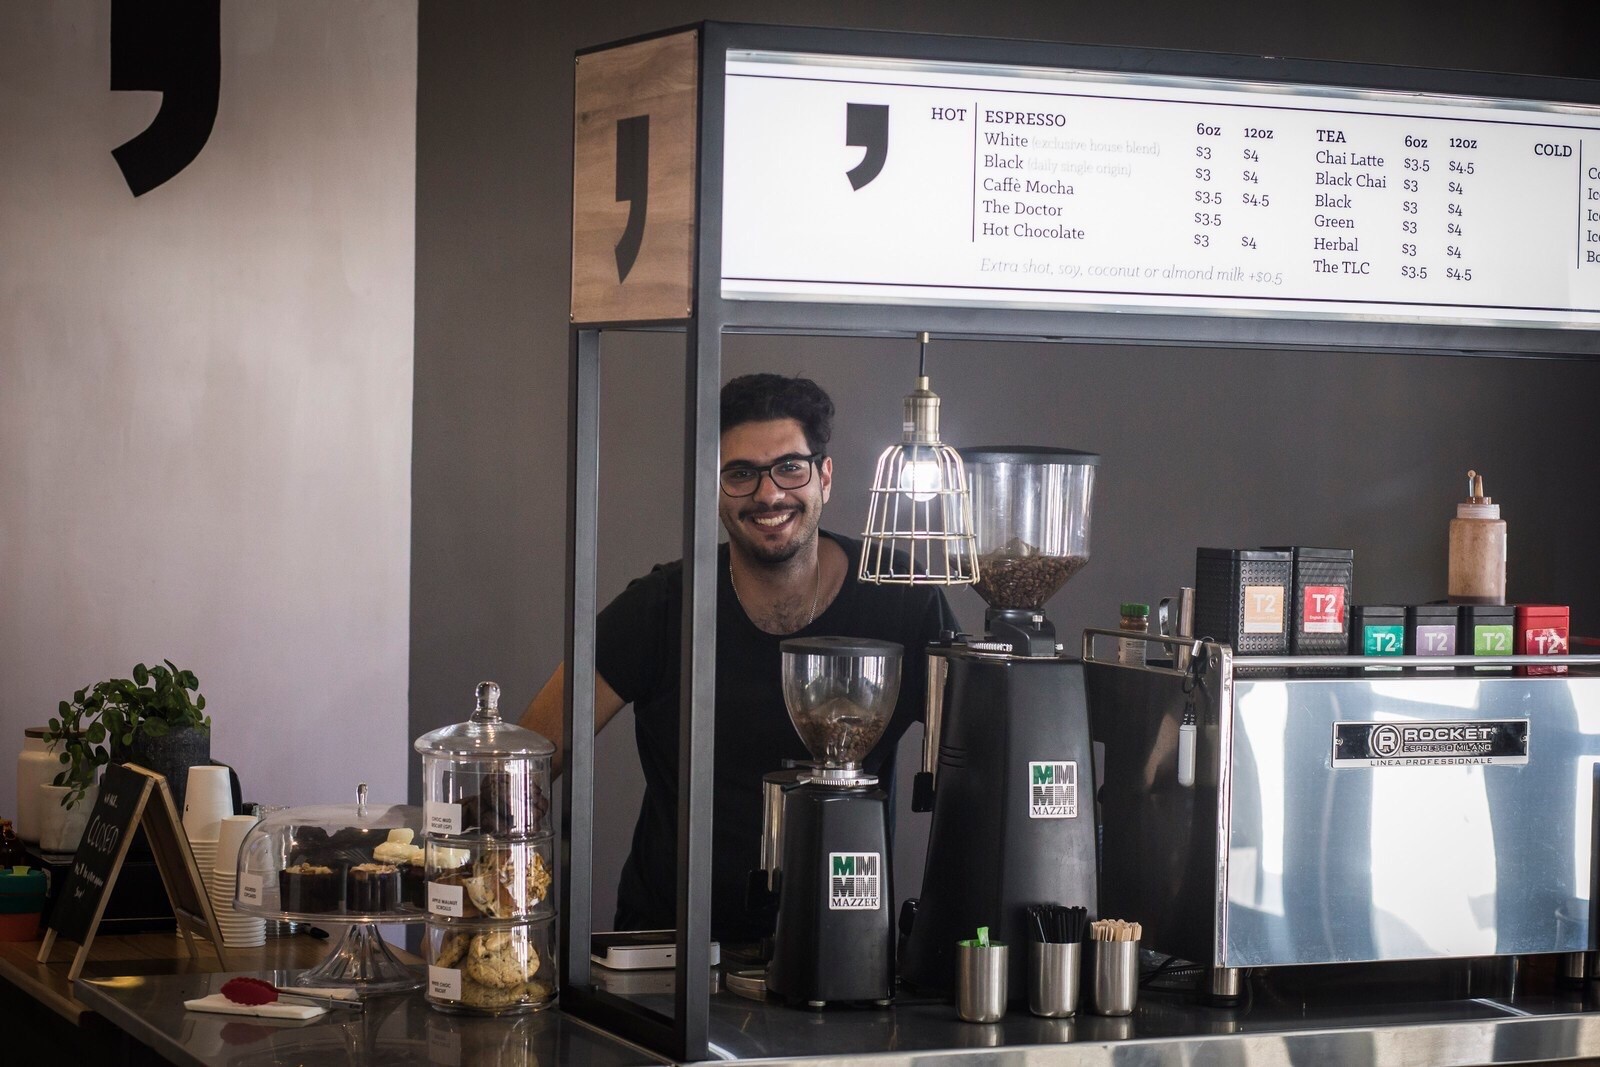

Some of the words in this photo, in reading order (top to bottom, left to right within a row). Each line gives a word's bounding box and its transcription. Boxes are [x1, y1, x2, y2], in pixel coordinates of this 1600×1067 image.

[931, 107, 967, 122] HOT
[985, 111, 1066, 127] ESPRESSO
[1196, 123, 1221, 136] 6oz
[1244, 128, 1274, 140] 12oz
[1316, 130, 1346, 143] TEA
[984, 132, 1028, 147] White
[1032, 136, 1087, 150] (exclusive
[1090, 139, 1124, 153] house
[1126, 141, 1160, 156] blend)
[1404, 136, 1428, 148] 6oz
[1450, 138, 1477, 149] 12oz
[1534, 143, 1572, 157] COLD
[1196, 146, 1211, 160] $3
[1243, 148, 1259, 162] $4
[1316, 151, 1346, 165] Chai
[1350, 153, 1384, 167] Latte
[984, 155, 1024, 170] Black
[1028, 158, 1058, 173] (daily
[1061, 160, 1093, 175] single
[1096, 164, 1131, 177] origin)
[1404, 158, 1430, 172] $3.5
[1449, 161, 1474, 174] $4.5
[1196, 168, 1211, 181] $3
[1243, 170, 1258, 184] $4
[1316, 172, 1352, 186] Black
[1356, 175, 1386, 188] Chai
[983, 178, 1021, 192] Caffè
[1026, 180, 1074, 195] Mocha
[1404, 180, 1418, 192] $3
[1448, 182, 1463, 194] $4
[1588, 188, 1600, 200] Ic
[1195, 191, 1222, 204] $3.5
[1242, 193, 1269, 207] $4.5
[1315, 194, 1352, 208] Black
[983, 201, 1010, 214] The
[1014, 202, 1063, 216] Doctor
[1403, 201, 1418, 214] $3
[1448, 203, 1462, 216] $4
[1588, 209, 1600, 222] Ic
[1194, 212, 1222, 226] $3.5
[1314, 215, 1354, 228] Green
[983, 223, 1010, 237] Hot
[1014, 225, 1085, 240] Chocolate
[1402, 221, 1417, 234] $3
[1447, 223, 1462, 236] $4
[1587, 230, 1600, 242] Ic
[1194, 234, 1209, 248] $3
[1241, 237, 1256, 249] $4
[1314, 238, 1358, 252] Herbal
[1402, 244, 1416, 256] $3
[1447, 246, 1461, 258] $4
[980, 258, 1018, 273] Extra
[1023, 260, 1054, 276] shot,
[1058, 263, 1083, 278] soy,
[1088, 264, 1141, 278] coconut
[1144, 267, 1159, 278] or
[1163, 266, 1213, 281] almond
[1217, 267, 1244, 282] milk
[1248, 271, 1283, 286] +$0.5
[1313, 260, 1339, 274] The
[1342, 262, 1370, 274] TLC
[1401, 266, 1427, 279] $3.5
[1446, 268, 1472, 281] $4.5
[1253, 594, 1276, 613] T2
[1312, 594, 1336, 613] T2
[1373, 634, 1396, 652] T2
[1425, 633, 1448, 650] T2
[1483, 633, 1505, 650] T2
[1535, 635, 1558, 654] T2
[1405, 728, 1492, 740] ROCKET
[1032, 806, 1075, 815] MAZZER
[88, 815, 119, 855] CLOSED
[832, 898, 878, 906] MAZZER
